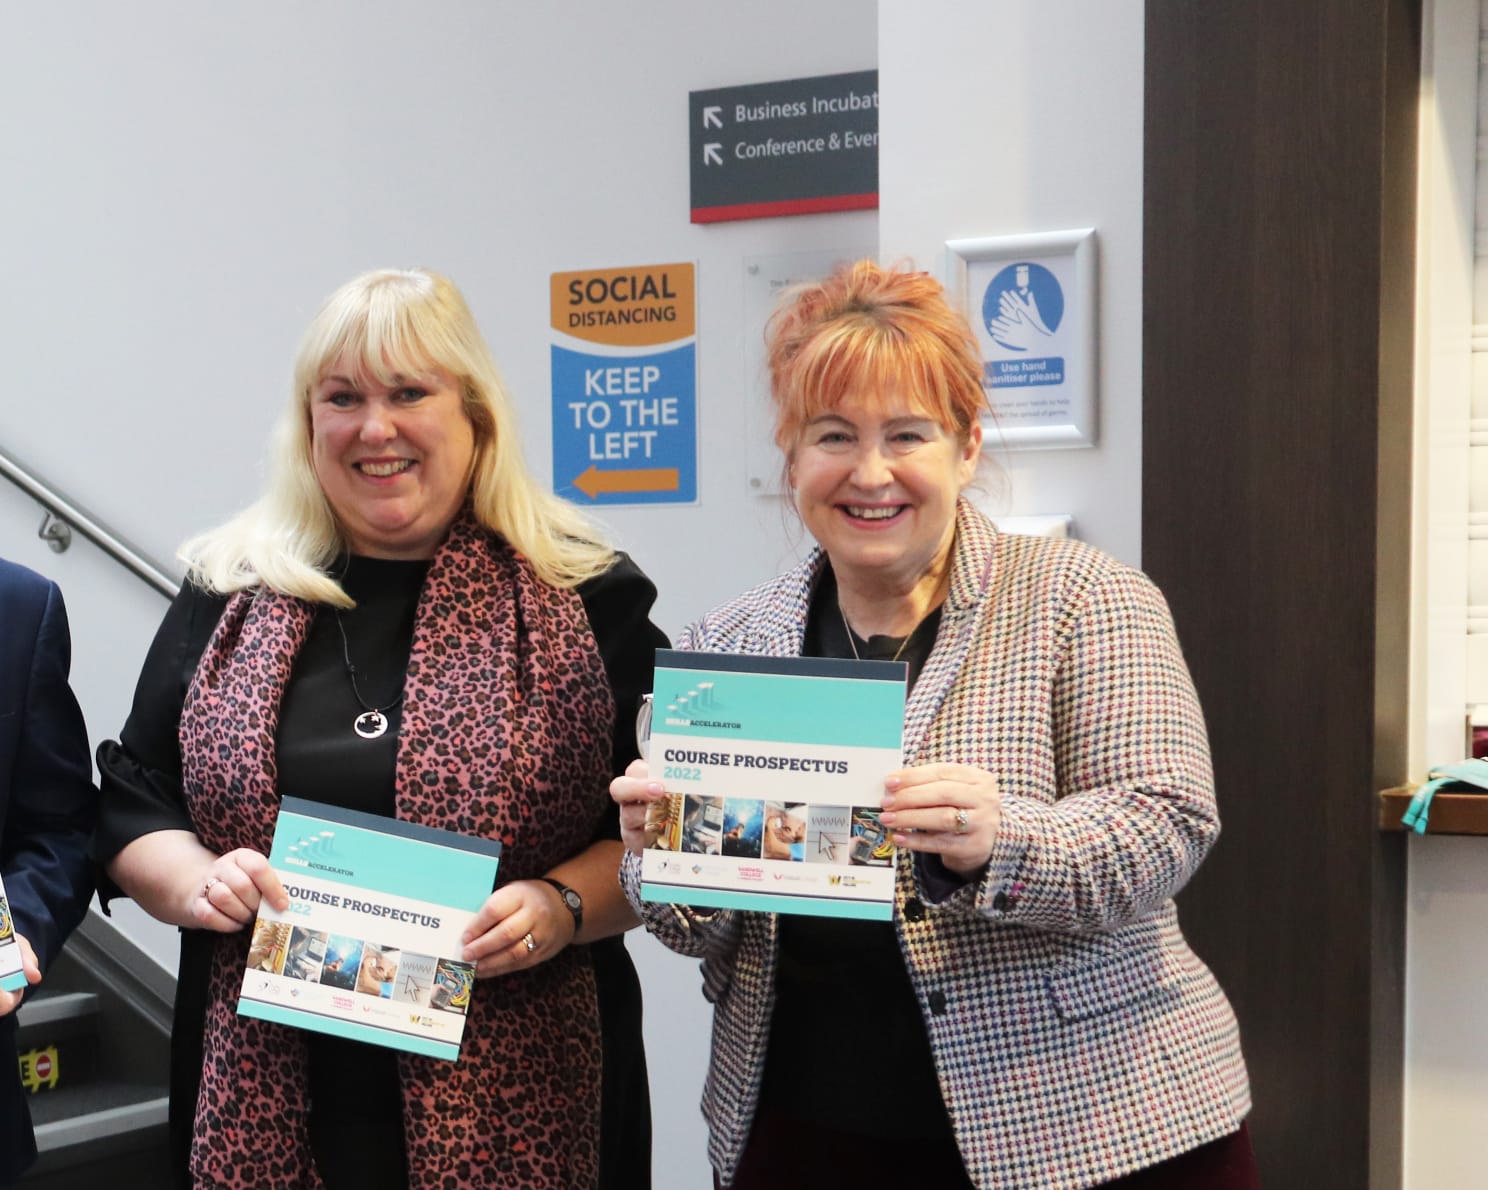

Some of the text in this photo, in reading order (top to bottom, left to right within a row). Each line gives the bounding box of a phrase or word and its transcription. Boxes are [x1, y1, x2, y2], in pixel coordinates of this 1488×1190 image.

[735, 91, 879, 122] Business Incubat
[735, 137, 825, 160] Conference
[828, 132, 841, 150] &
[568, 273, 677, 306] SOCIAL
[568, 306, 677, 328] DISTANCING
[1001, 361, 1046, 372] Use hand
[1030, 372, 1061, 384] please
[585, 366, 661, 396] KEEP
[568, 397, 679, 430] TO THE
[588, 430, 658, 460] LEFT
[663, 765, 702, 782] 2022
[664, 749, 849, 775] COURSE PROSPECTUS
[288, 901, 312, 917] 022
[341, 897, 442, 930] PROSPECTUS
